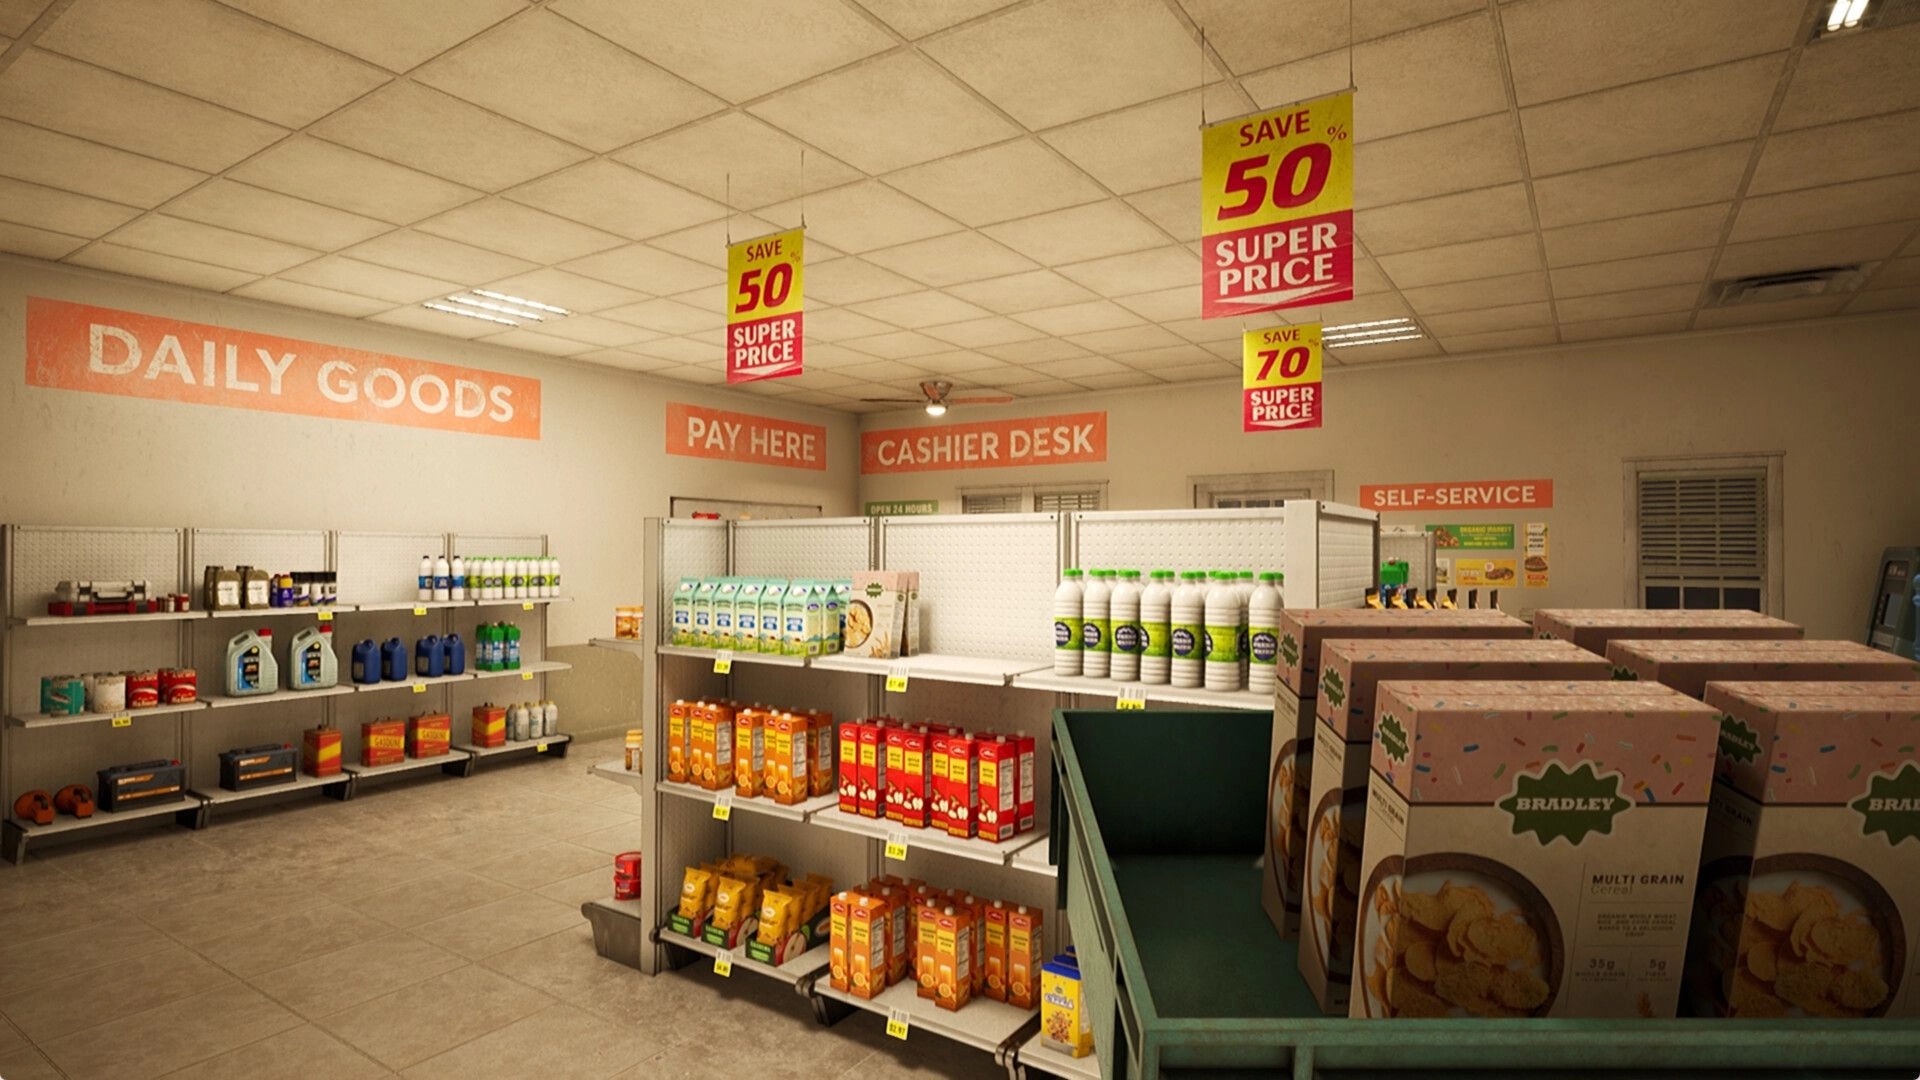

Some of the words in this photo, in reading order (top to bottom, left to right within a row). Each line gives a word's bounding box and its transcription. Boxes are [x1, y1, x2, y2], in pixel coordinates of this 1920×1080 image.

[1240, 110, 1310, 147] SAVE
[1327, 124, 1347, 142] %
[1217, 142, 1332, 221] 50
[746, 239, 782, 262] SAVE
[1216, 222, 1337, 267] SUPER
[1219, 253, 1333, 296] PRICE
[735, 262, 793, 313] 50
[734, 319, 796, 347] SUPER
[1263, 329, 1300, 344] SAVE
[735, 340, 794, 368] PRICE
[1256, 347, 1310, 381] 70
[89, 323, 297, 395] DAILY
[317, 360, 514, 423] GOODS
[1251, 386, 1314, 406] SUPER
[1252, 402, 1312, 420] PRICE
[687, 416, 741, 451] PAY
[751, 425, 816, 462] HERE
[877, 432, 999, 467] CASHIER
[1009, 423, 1094, 459] DESK
[1374, 485, 1536, 507] SELF-SERVICE
[870, 504, 891, 514] OPEN
[893, 504, 903, 514] 24
[905, 503, 932, 514] HOURS
[1516, 798, 1615, 811] BRADLEY
[1591, 884, 1633, 895] Cereal
[1592, 874, 1635, 885] MULTI
[1640, 874, 1685, 885] GRAIN
[1590, 958, 1615, 970] 35g
[1650, 958, 1667, 970] 5g
